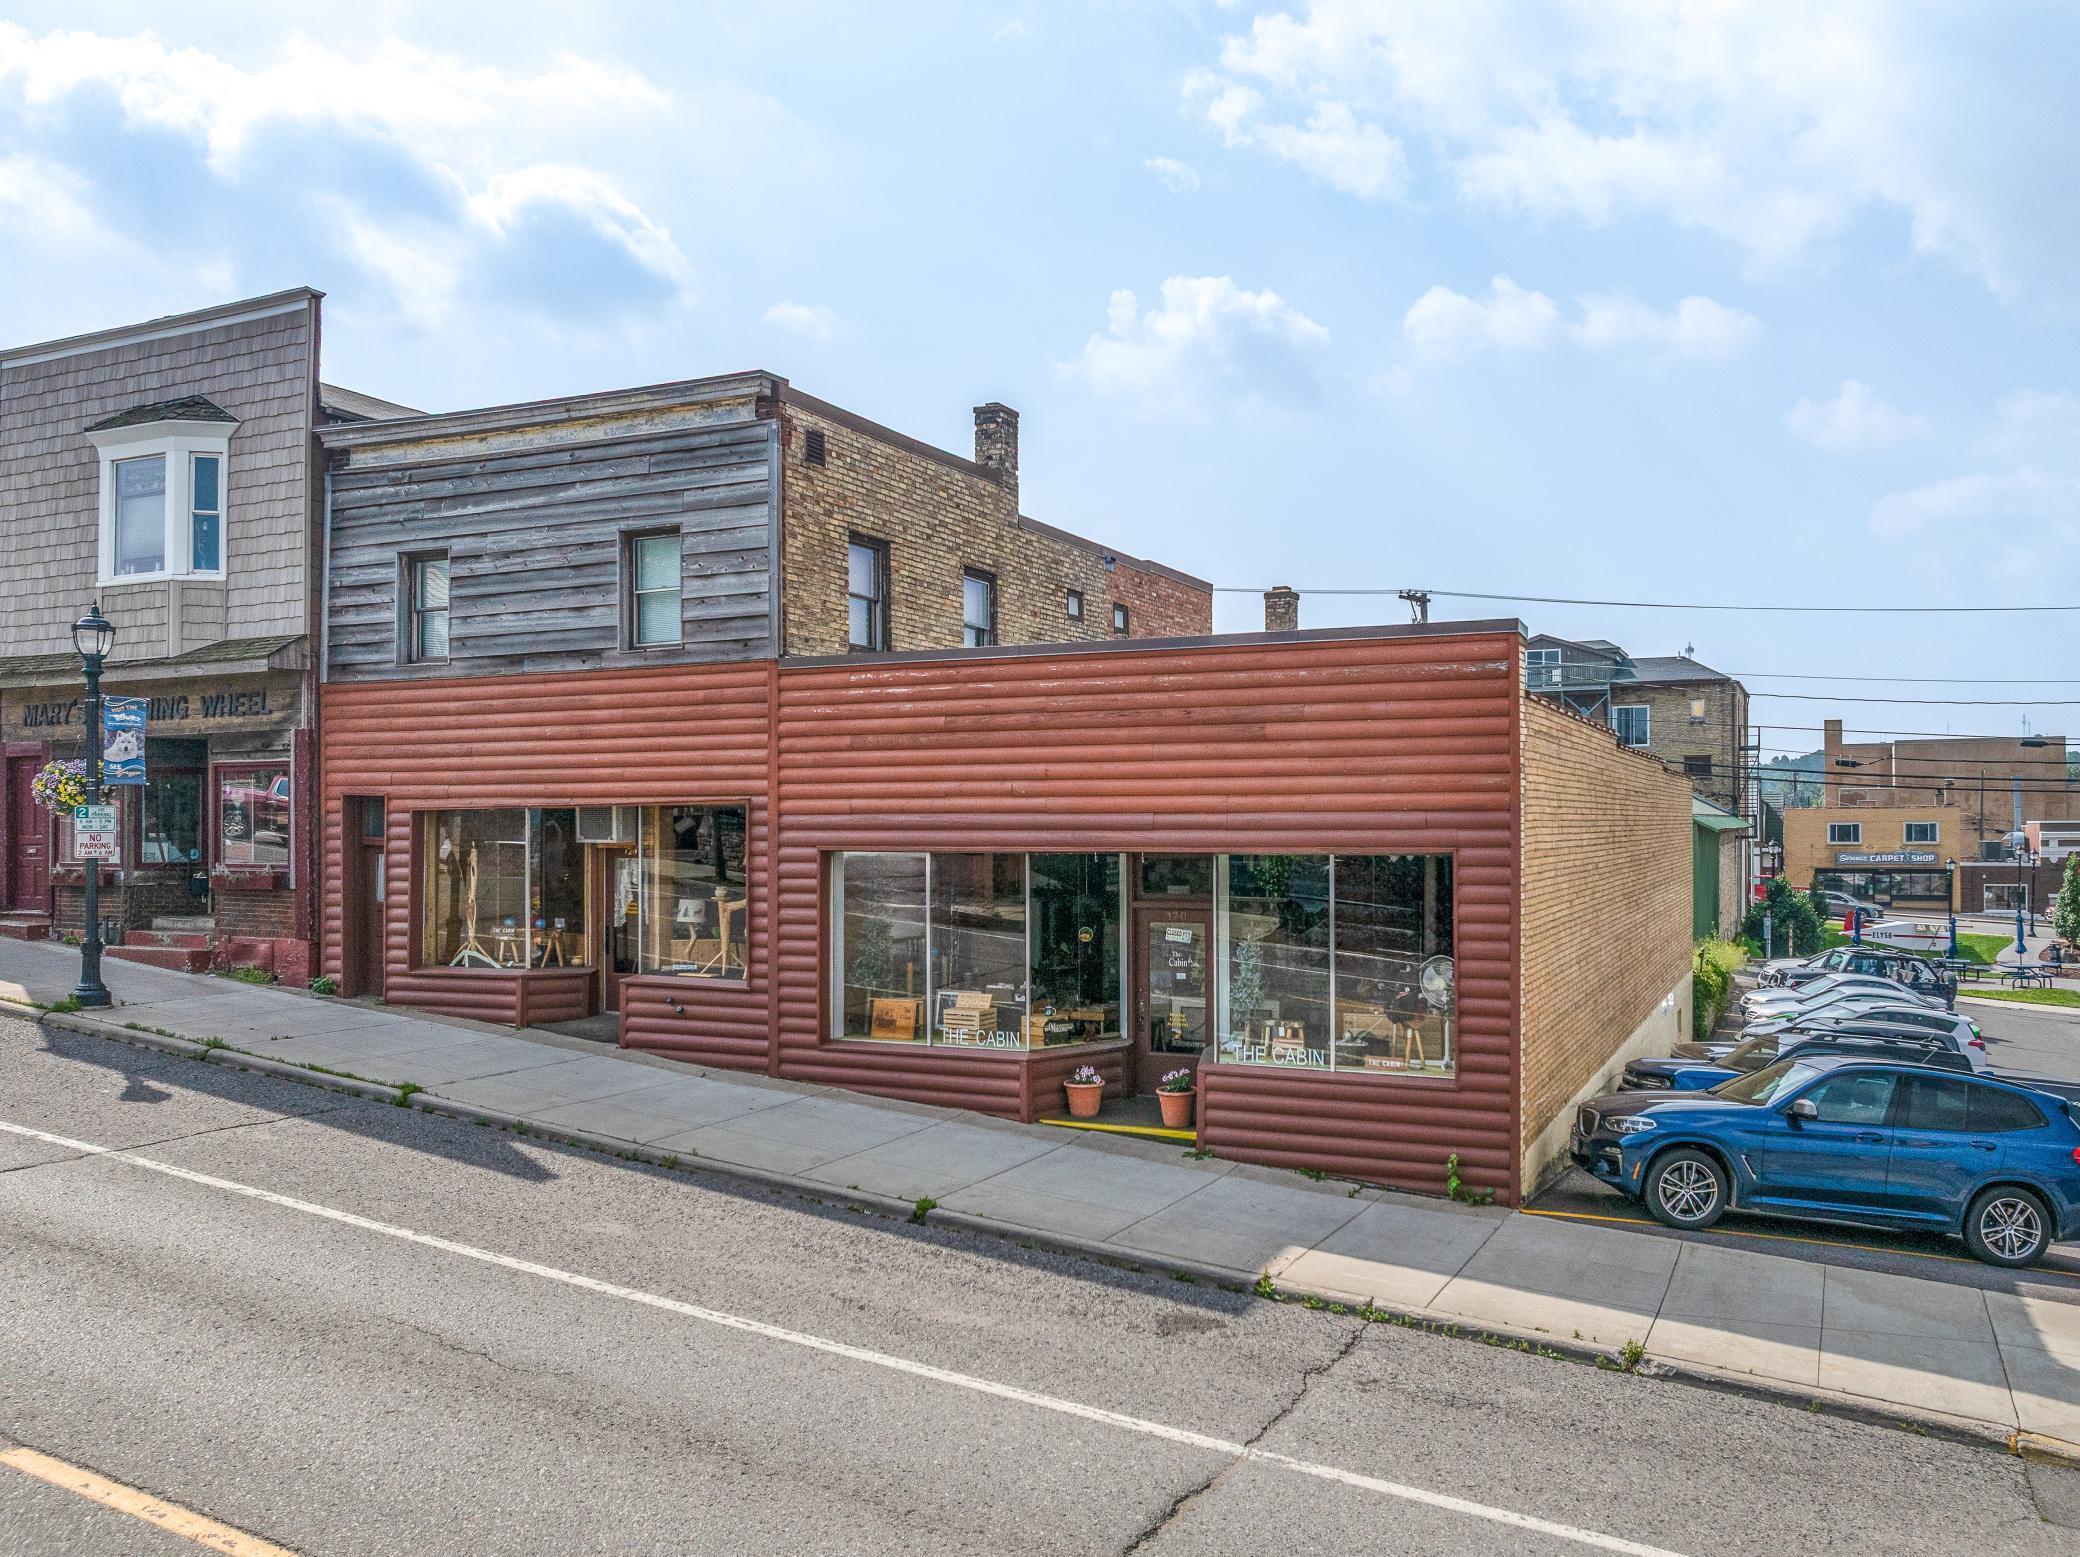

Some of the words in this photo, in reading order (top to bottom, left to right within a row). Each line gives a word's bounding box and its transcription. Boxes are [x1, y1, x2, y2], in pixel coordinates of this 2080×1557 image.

[200, 688, 272, 718] WHEEL
[79, 807, 87, 817] 2
[89, 834, 102, 842] NO
[1869, 854, 1905, 862] CARPET
[1911, 854, 1935, 862] SHOP
[1166, 928, 1182, 937] CLOSED
[1168, 957, 1188, 967] Cabin
[940, 1027, 969, 1046] THE
[976, 1029, 1020, 1048] CABIN
[1234, 1044, 1266, 1063] THE
[1272, 1047, 1325, 1066] CABIN
[1382, 1060, 1401, 1068] CABIN
